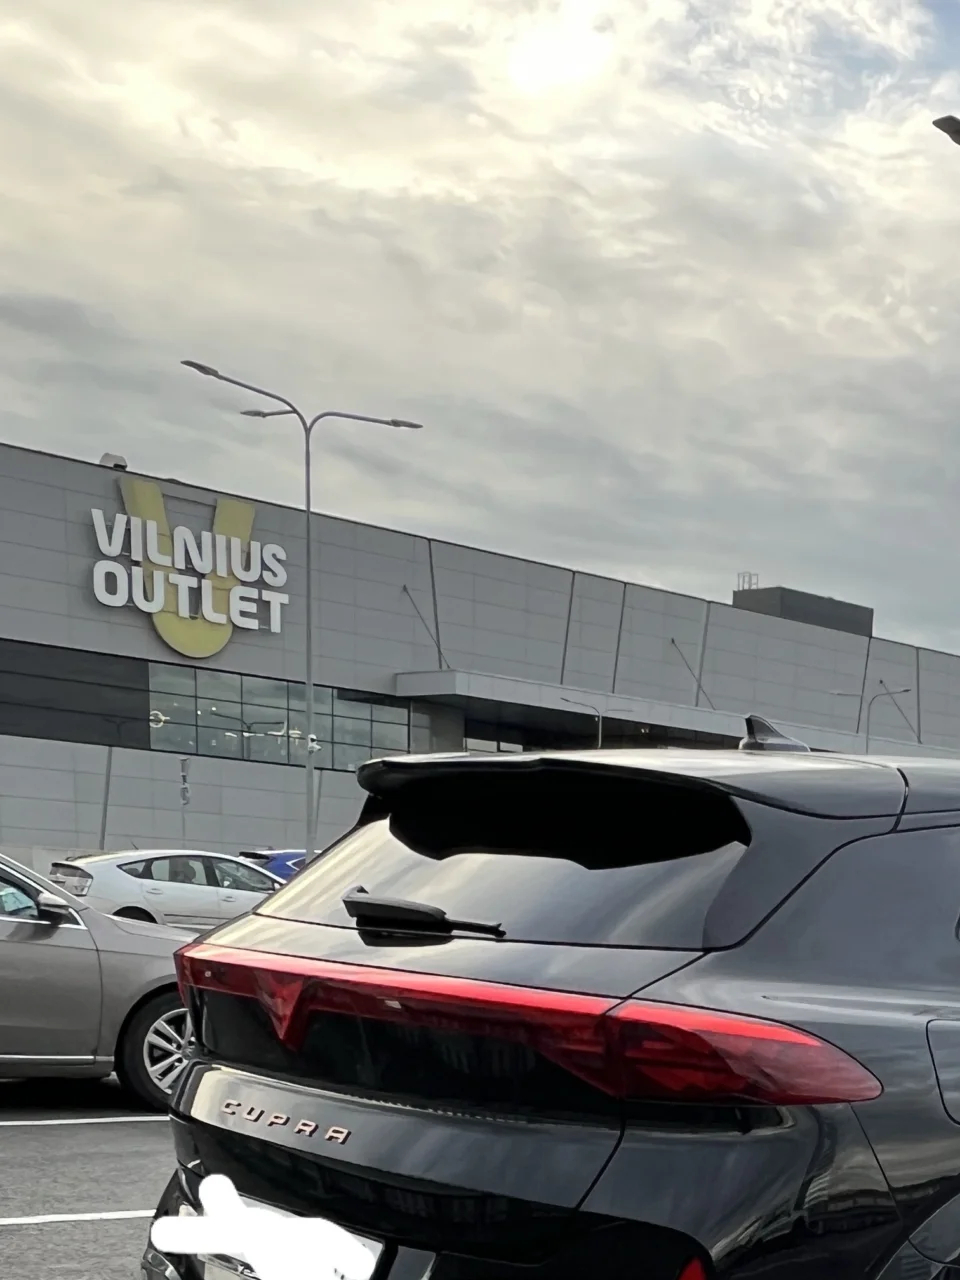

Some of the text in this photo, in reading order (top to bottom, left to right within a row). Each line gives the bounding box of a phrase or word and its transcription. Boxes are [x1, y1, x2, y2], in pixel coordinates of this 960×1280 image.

[91, 508, 288, 587] VILNIUS
[93, 560, 290, 633] OUTLET
[221, 1099, 352, 1145] CUPRA
